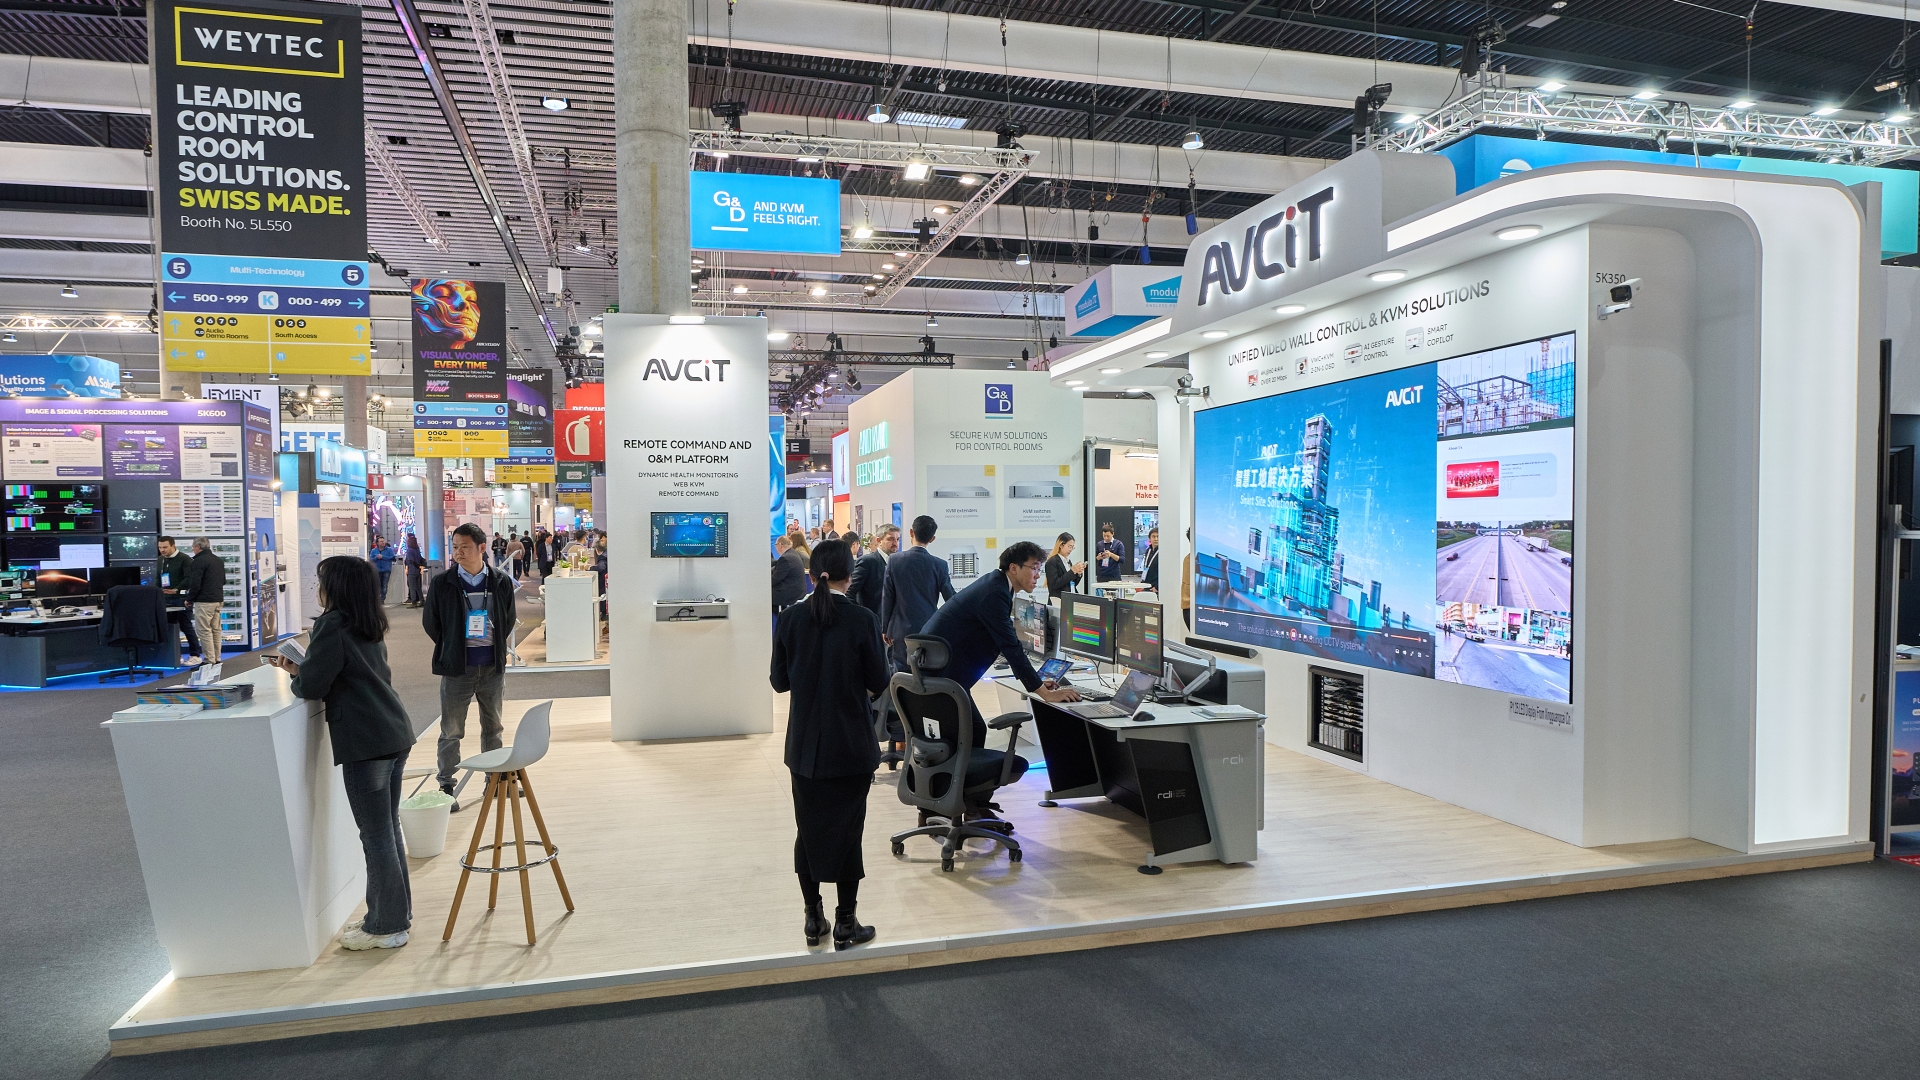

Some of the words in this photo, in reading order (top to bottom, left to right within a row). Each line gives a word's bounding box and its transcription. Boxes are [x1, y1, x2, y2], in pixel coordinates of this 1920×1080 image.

[194, 27, 324, 58] WEYTEC
[177, 84, 302, 112] LEADING
[177, 110, 314, 138] CONTROL
[178, 136, 264, 160] ROOM
[178, 162, 350, 190] SOLUTIONS.
[180, 188, 260, 210] SWISS
[268, 194, 350, 216] MADE.
[754, 201, 778, 212] AND
[780, 203, 804, 213] KVM
[181, 216, 220, 228] Booth
[226, 218, 247, 230] No.
[250, 219, 292, 232] 5L550
[754, 213, 784, 224] FEELS
[787, 215, 821, 226] RIGHT.
[172, 262, 186, 274] 5
[230, 266, 305, 277] Multi-Technology
[347, 269, 358, 282] 5
[1595, 272, 1625, 284] 5K350
[193, 293, 217, 303] 500
[226, 295, 248, 304] 999
[262, 294, 274, 306] K
[288, 297, 311, 306] 000
[320, 298, 341, 307] 499
[1228, 348, 1259, 367] UNIFIED
[1261, 340, 1287, 358] VIDEO
[1289, 331, 1314, 350] WALL
[1316, 317, 1366, 342] CONTROL
[1368, 314, 1378, 327] &
[1380, 302, 1408, 325] KVM
[1410, 280, 1490, 316] SOLUTIONS
[1427, 324, 1448, 334] SMART
[1370, 337, 1394, 348] GESTURE
[1427, 334, 1454, 346] COPILOT
[420, 351, 453, 359] VISUAL
[455, 352, 500, 362] WONDER,
[1363, 350, 1388, 361] CONTROL
[1261, 377, 1271, 386] OVER
[1277, 374, 1288, 382] Mbps
[950, 431, 982, 439] SECURE
[984, 431, 1002, 439] KVM
[1004, 431, 1048, 440] SOLUTIONS
[624, 440, 667, 448] REMOTE
[670, 440, 726, 449] COMMAND
[729, 441, 752, 449] AND
[973, 442, 1011, 451] CONTROL
[1013, 443, 1043, 451] ROOMS
[648, 455, 672, 463] O&M
[675, 455, 729, 463] PLATFORM
[1236, 464, 1314, 488] 智慧工地解决方案
[1240, 495, 1254, 505] Smart
[1255, 496, 1266, 507] Site
[1268, 497, 1298, 510] Solutions
[1238, 623, 1246, 631] The
[1247, 624, 1265, 635] solution
[1324, 637, 1340, 647] CCTV
[1526, 704, 1536, 720] Display
[1223, 754, 1243, 765] rdi
[1158, 790, 1172, 799] rdi
